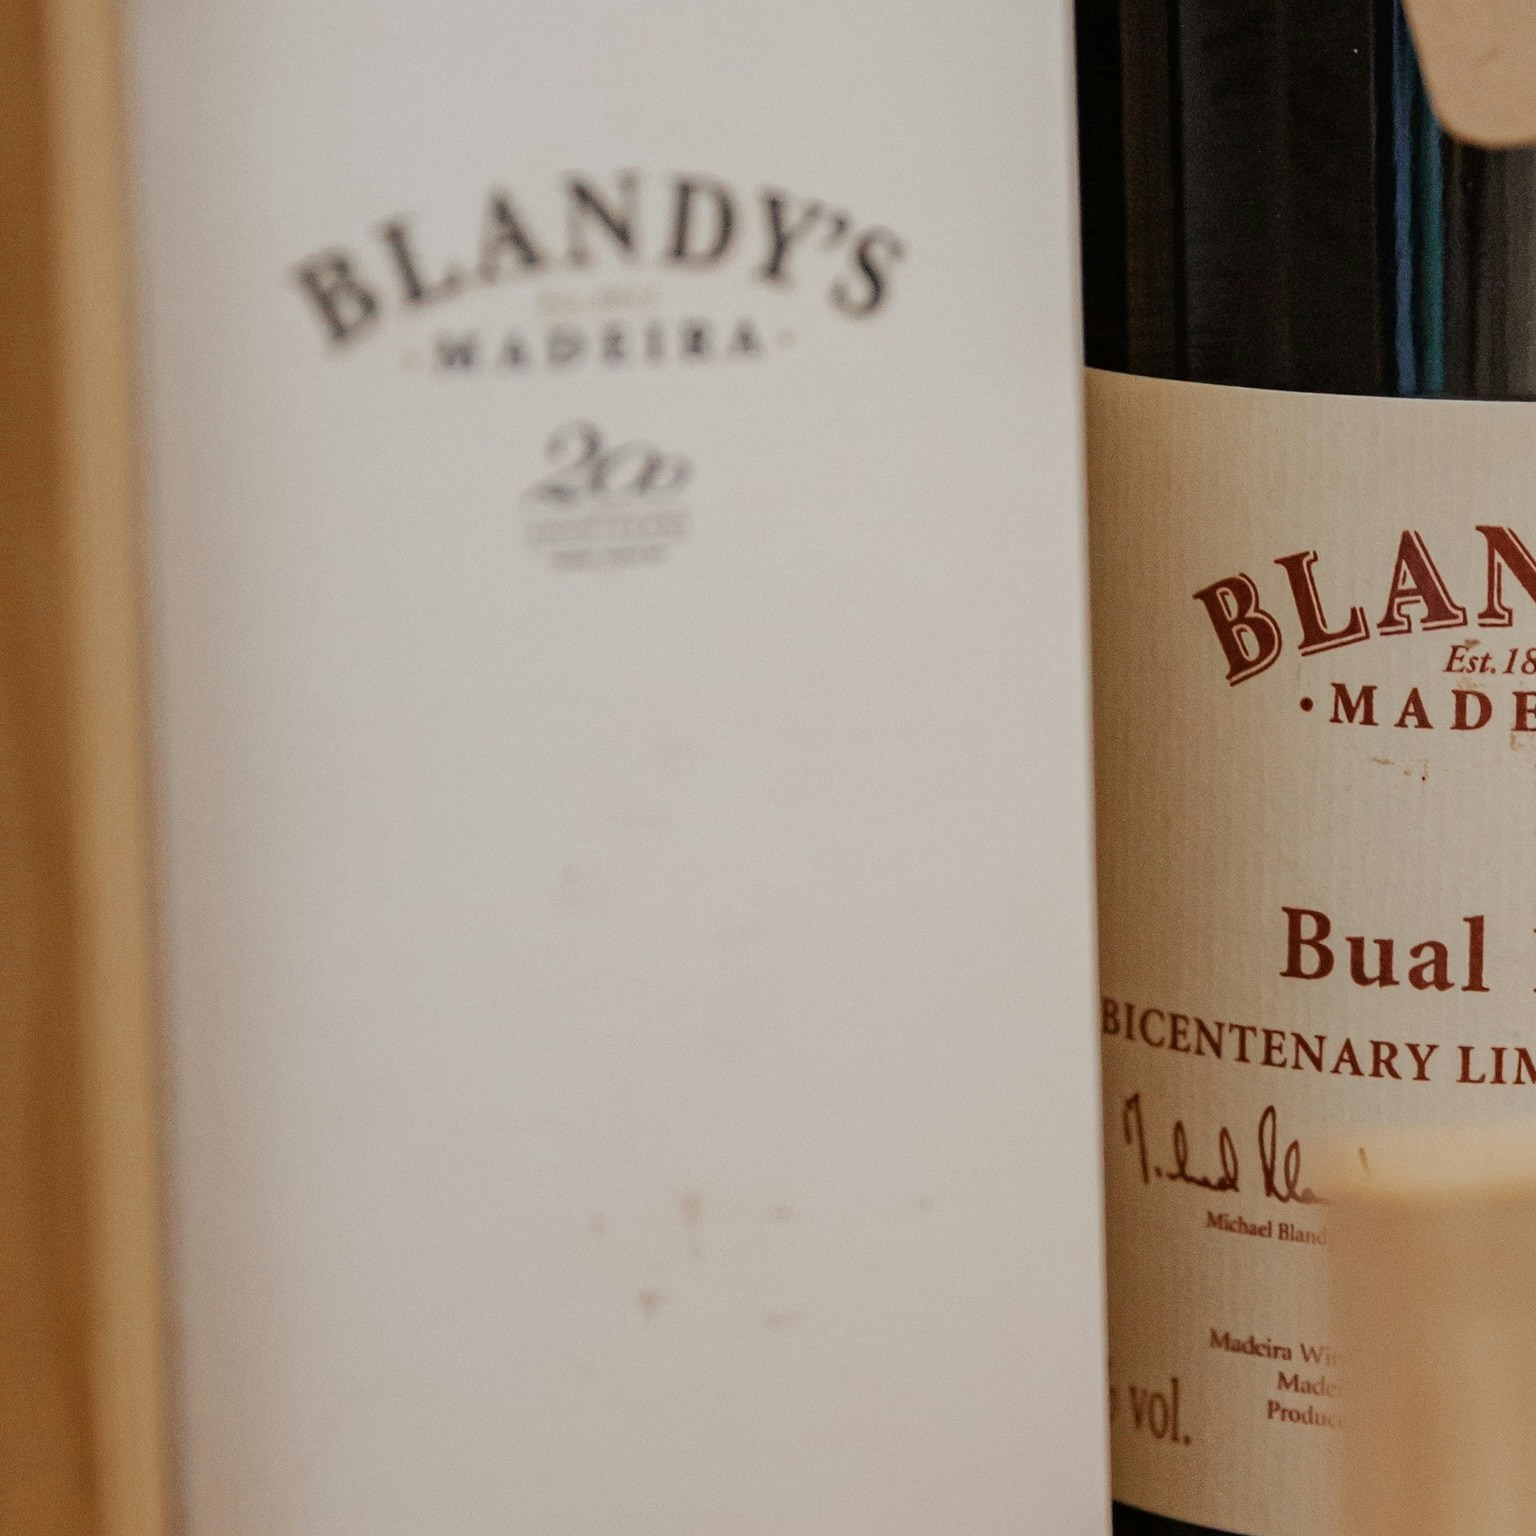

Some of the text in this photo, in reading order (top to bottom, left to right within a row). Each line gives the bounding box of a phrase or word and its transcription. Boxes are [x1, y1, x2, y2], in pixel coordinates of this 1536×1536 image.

[293, 170, 908, 352] BLANDY'S
[433, 317, 763, 374] MADEIRA
[1443, 644, 1497, 676] Est.
[1279, 906, 1491, 994] Bual
[1100, 996, 1439, 1081] BICENTENARY
[1205, 1210, 1332, 1246] Michael Bland
[1209, 1327, 1293, 1362] Madeira
[1276, 1373, 1342, 1400] Made
[1128, 1378, 1192, 1446] vol.
[1266, 1400, 1345, 1430] Produc
